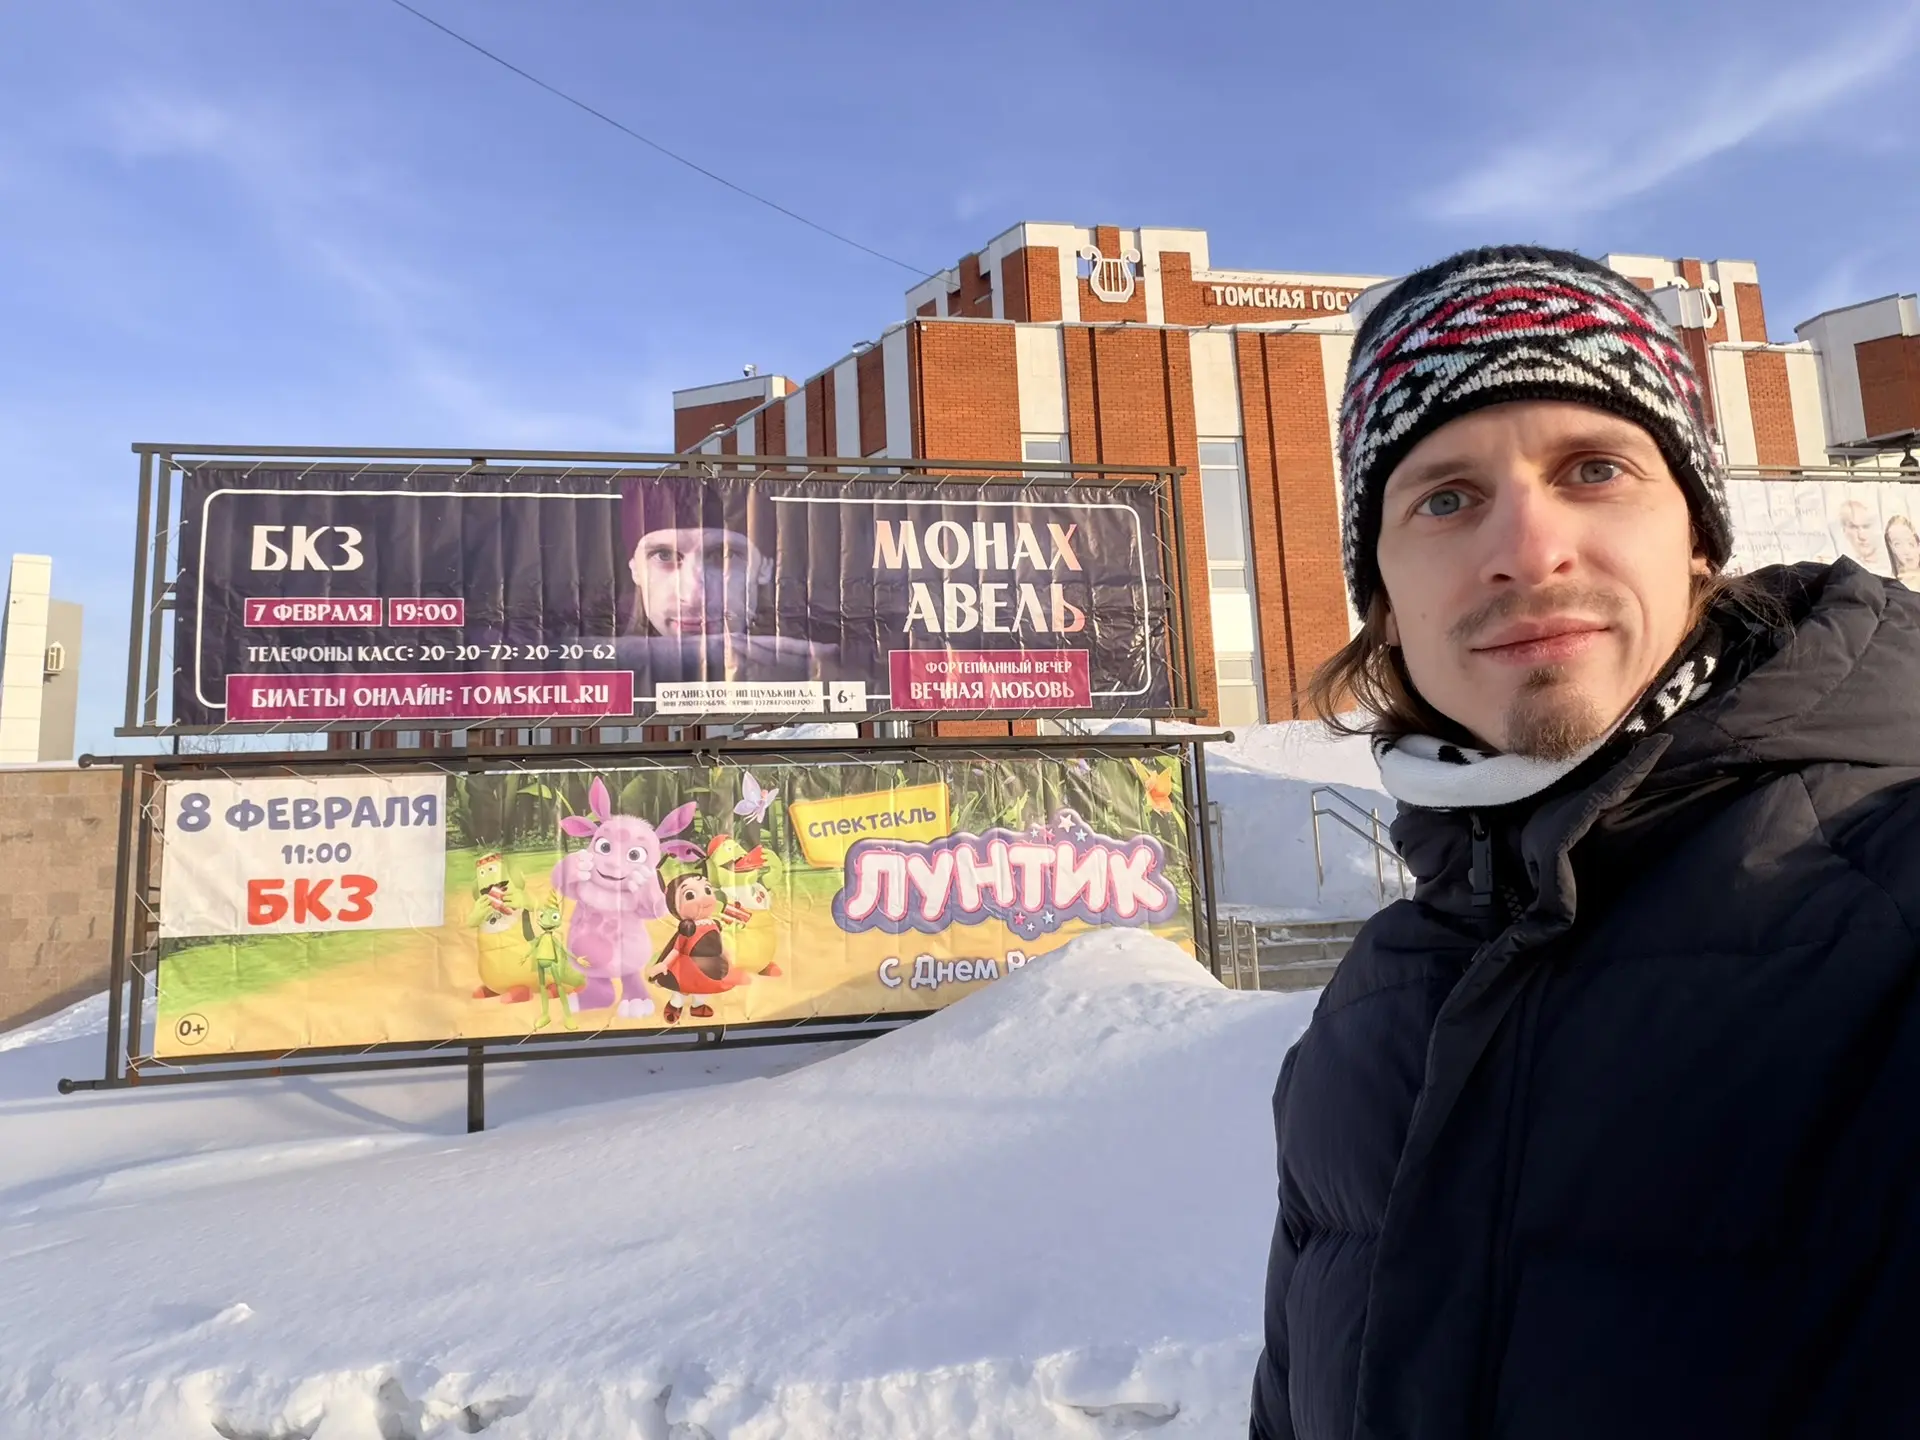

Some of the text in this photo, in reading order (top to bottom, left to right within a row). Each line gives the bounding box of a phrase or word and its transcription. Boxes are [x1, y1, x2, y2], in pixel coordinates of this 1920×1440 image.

[1211, 286, 1306, 309] ТОМСКАЯ
[250, 525, 364, 571] БКЗ
[872, 520, 1083, 571] МОНАХ
[252, 603, 373, 622] 7 ФЕВРАЛЯ
[395, 603, 458, 621] 19:00
[902, 582, 1086, 633] АВЕЛЬ
[248, 646, 353, 663] ТЕЛЕФОНЫ
[358, 645, 414, 662] КАСС:
[524, 644, 616, 661] 20-20-62
[925, 660, 1073, 674] ФОРТЕПИАННЫЙ ВЕЧЕР
[251, 683, 609, 708] БИЛЕТЫ ОНЛАЙН: TOMSKFIL.RU
[837, 690, 856, 704] 6+
[910, 681, 1075, 700] ВЕЧНАЯ ЛЮБОВЬ
[176, 792, 437, 833] 8 ФЕВРАЛЯ
[281, 842, 352, 864] 11:00
[844, 839, 1167, 922] ЛУНТИК
[246, 874, 378, 926] БКЗ
[879, 957, 903, 988] С
[911, 954, 999, 990] Днем
[179, 1020, 205, 1037] 0+
